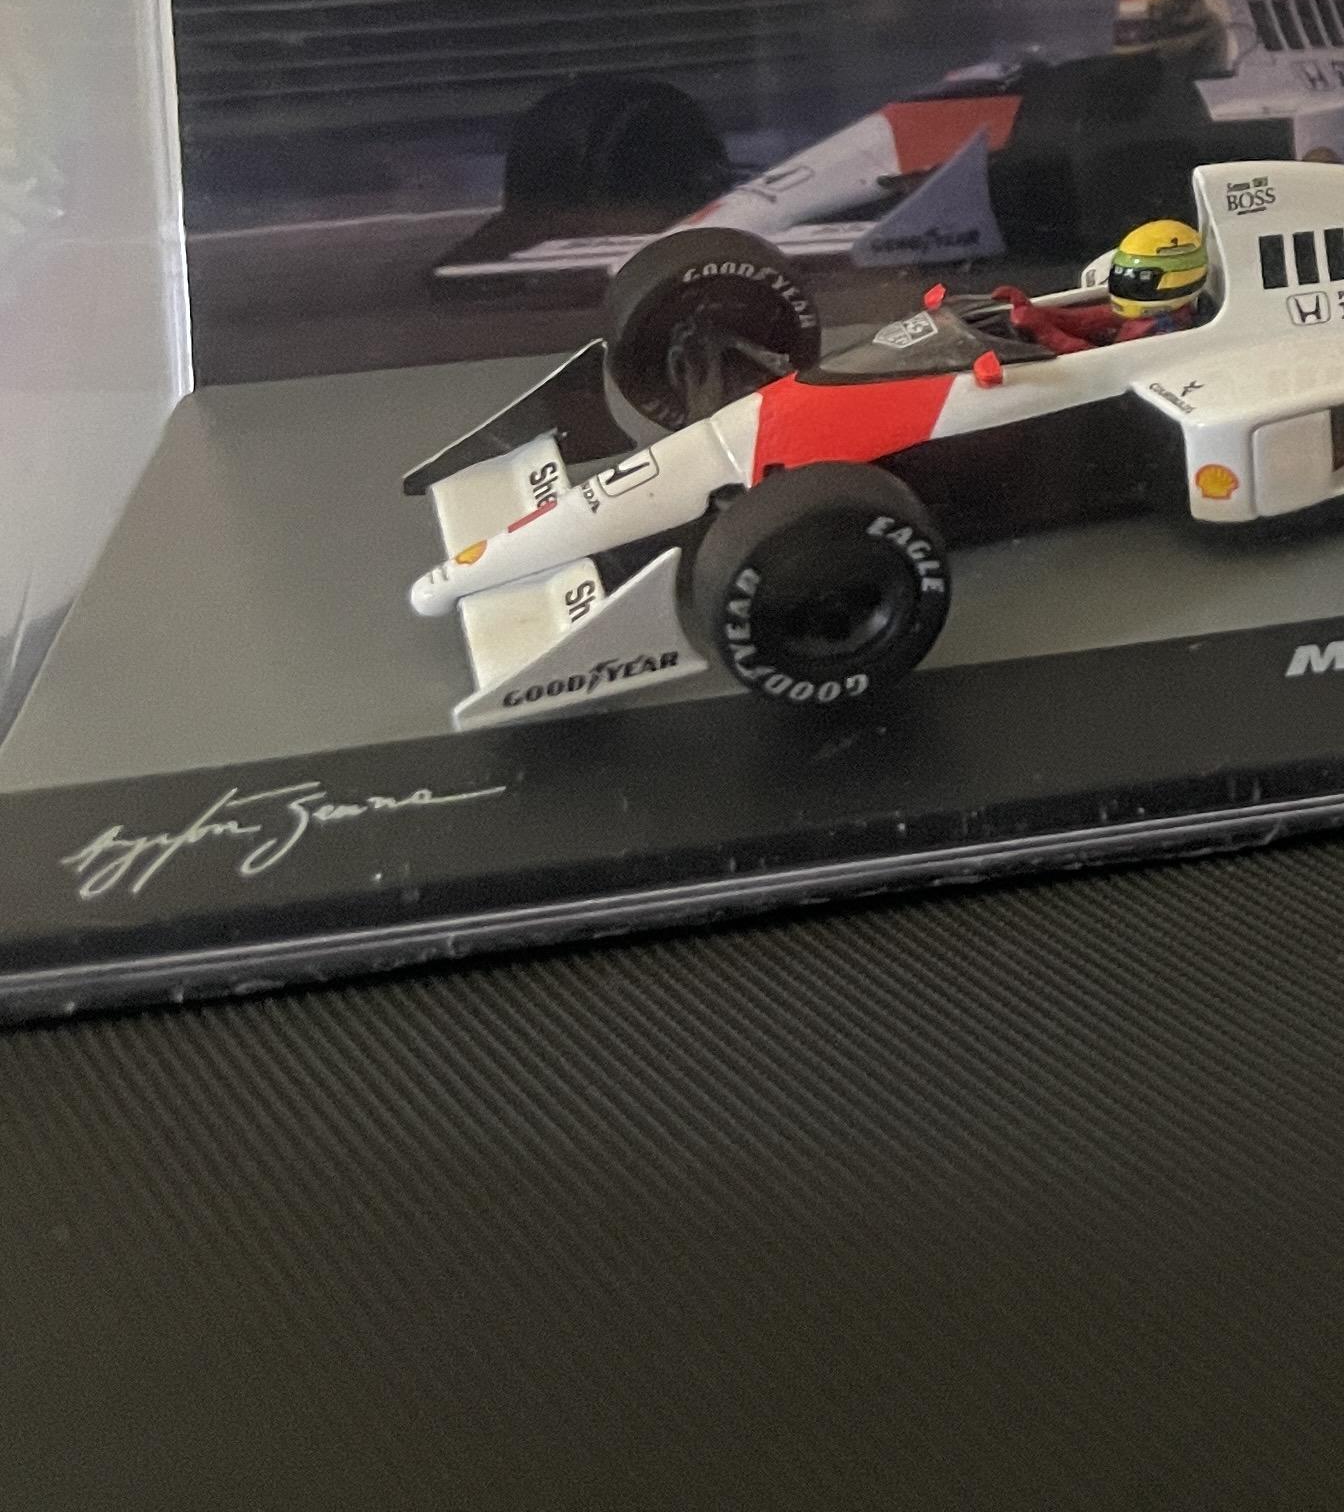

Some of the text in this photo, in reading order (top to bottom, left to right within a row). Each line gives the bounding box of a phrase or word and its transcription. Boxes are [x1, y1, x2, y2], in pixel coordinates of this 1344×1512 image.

[1227, 187, 1276, 211] BOSS
[866, 516, 946, 593] EAGLE
[726, 567, 869, 703] GOODYEAR
[502, 651, 680, 707] GOODYEAR
